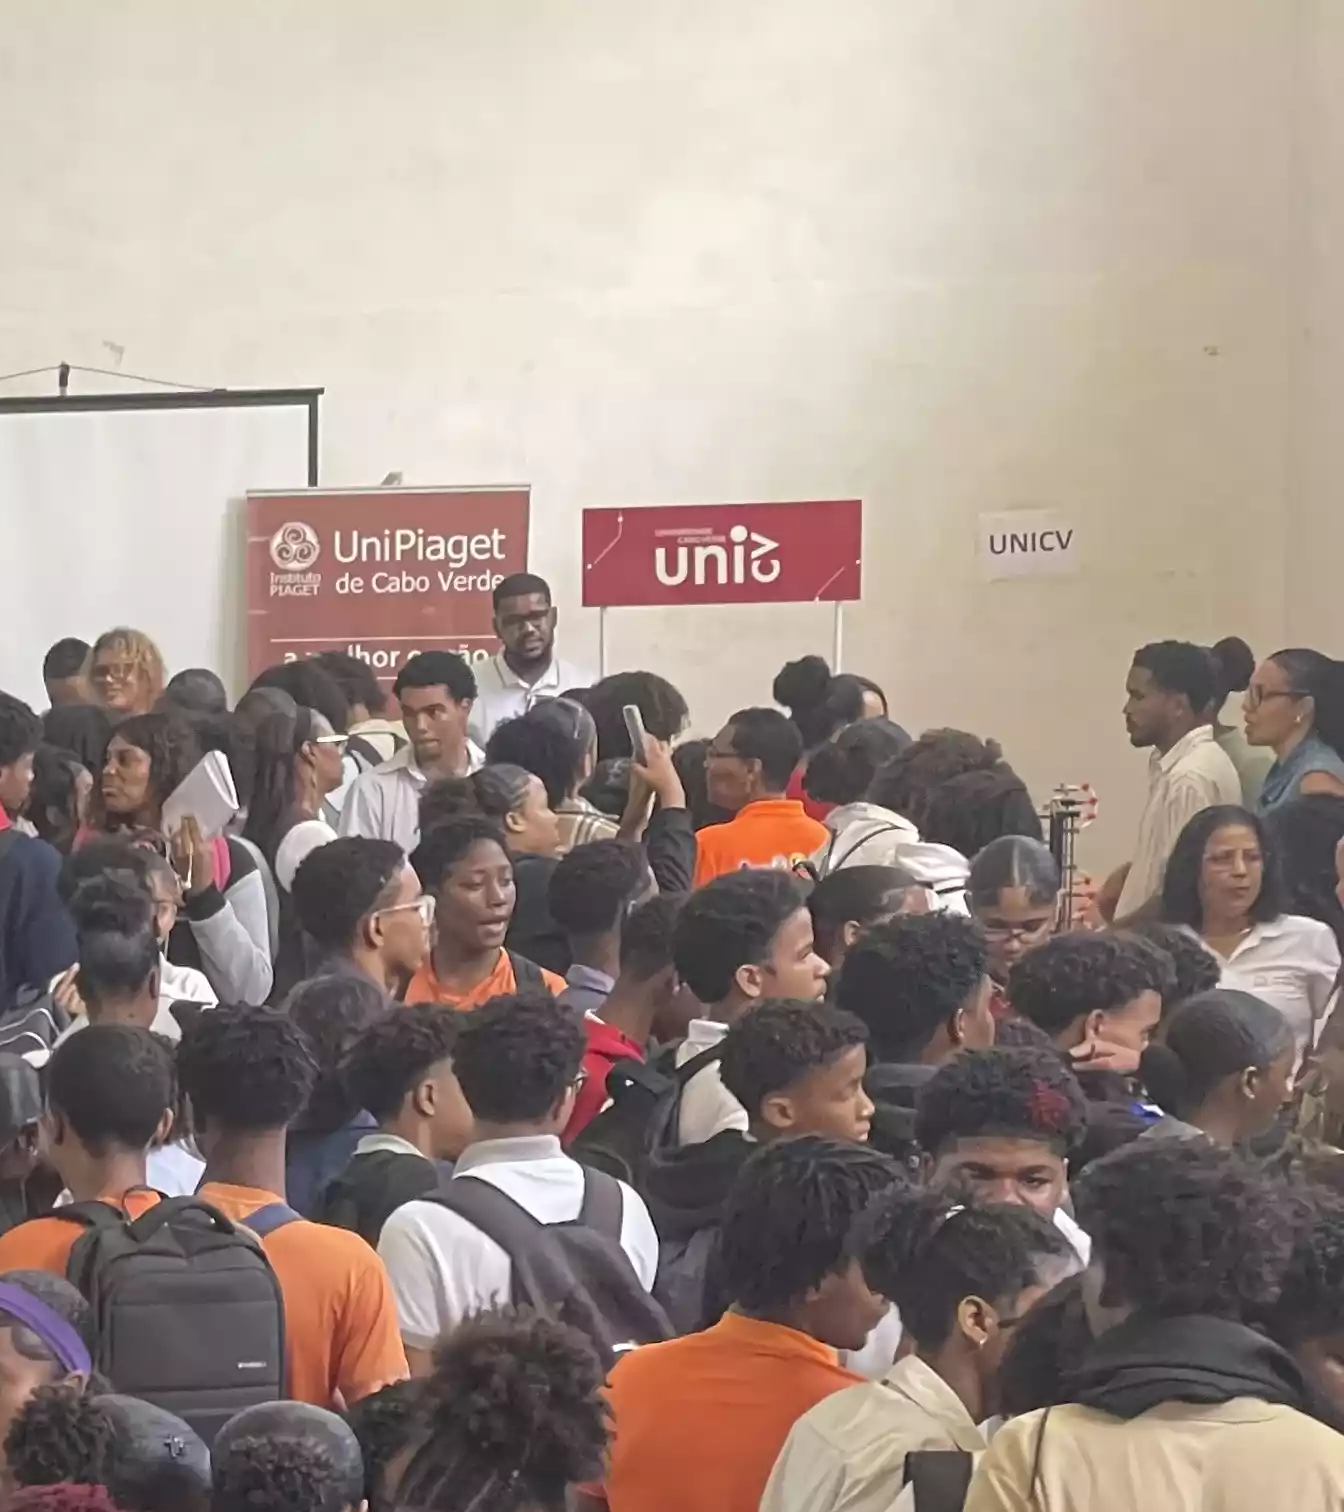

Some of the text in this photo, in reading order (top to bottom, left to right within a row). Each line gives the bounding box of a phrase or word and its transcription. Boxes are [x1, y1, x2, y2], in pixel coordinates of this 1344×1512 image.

[334, 528, 507, 568] UniPiaget
[990, 529, 1073, 555] UNICV
[270, 584, 320, 597] PIAGET
[335, 569, 505, 594] de Cabo Verde
